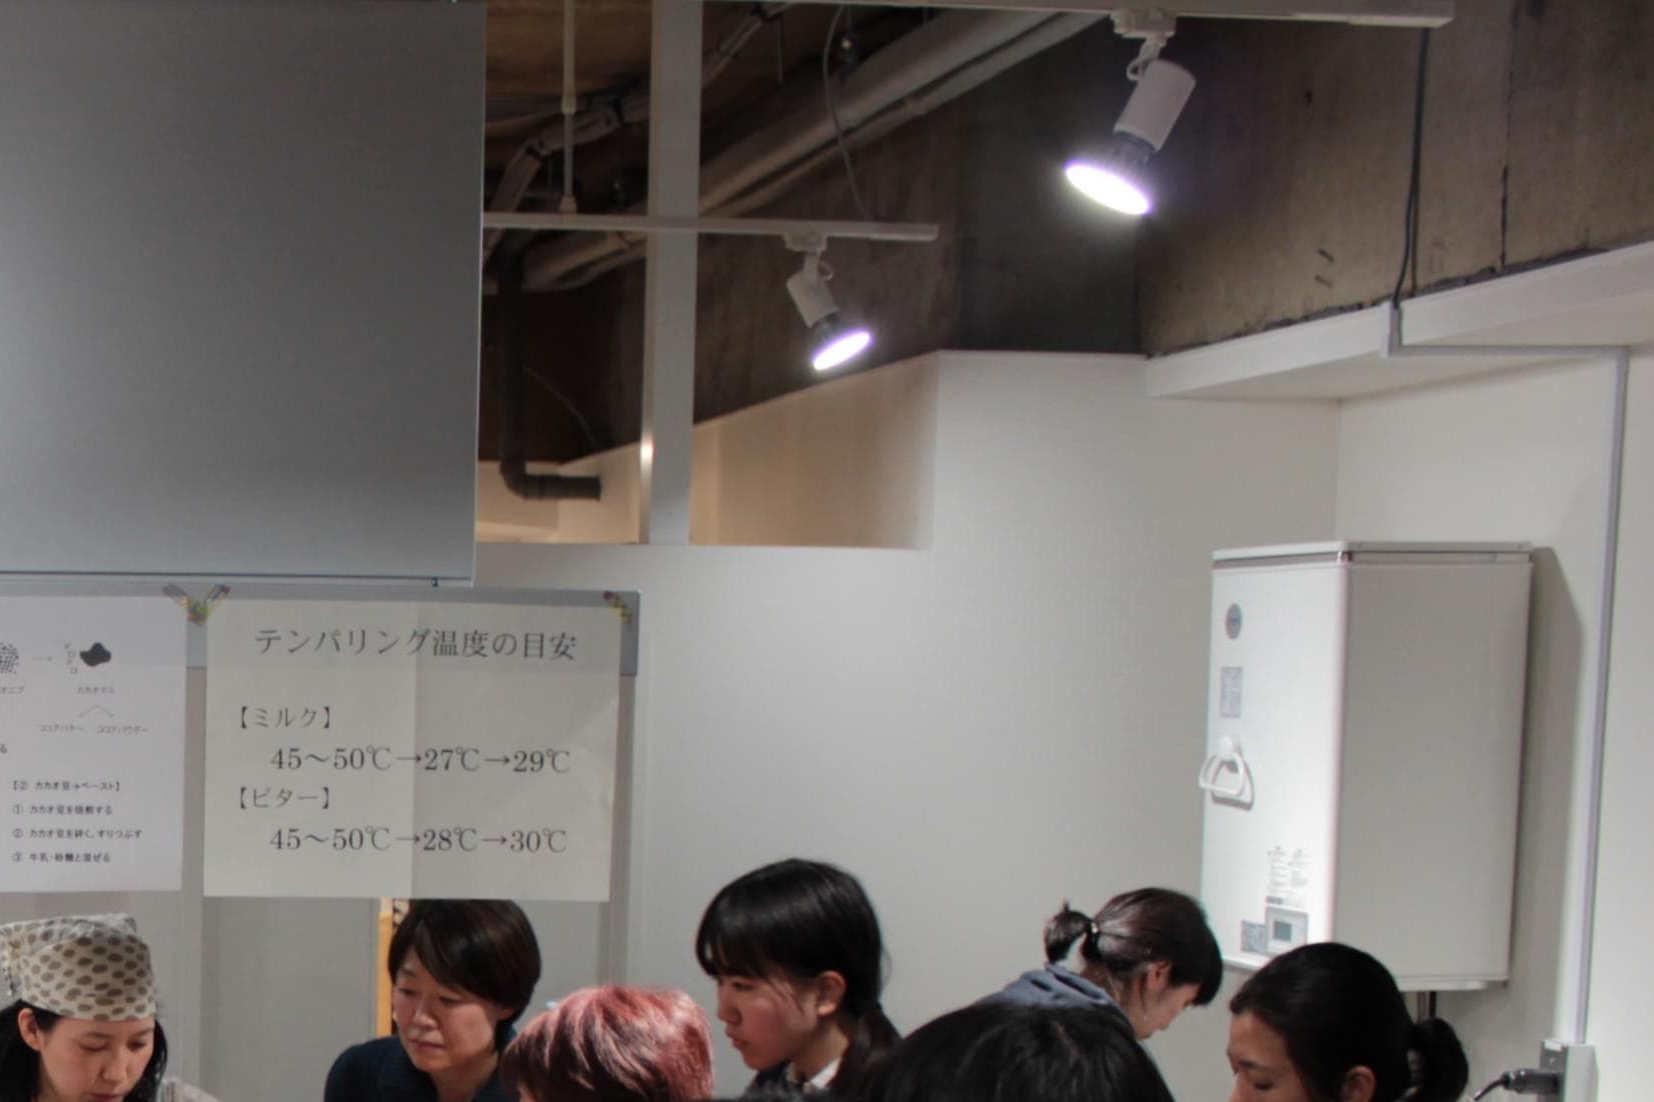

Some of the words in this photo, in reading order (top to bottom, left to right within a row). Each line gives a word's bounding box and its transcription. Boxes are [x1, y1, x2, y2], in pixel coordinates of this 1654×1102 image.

[256, 628, 577, 661] テンパリング温度の目安
[240, 705, 331, 730] 【ミルク】
[239, 786, 330, 811] 【ビター】
